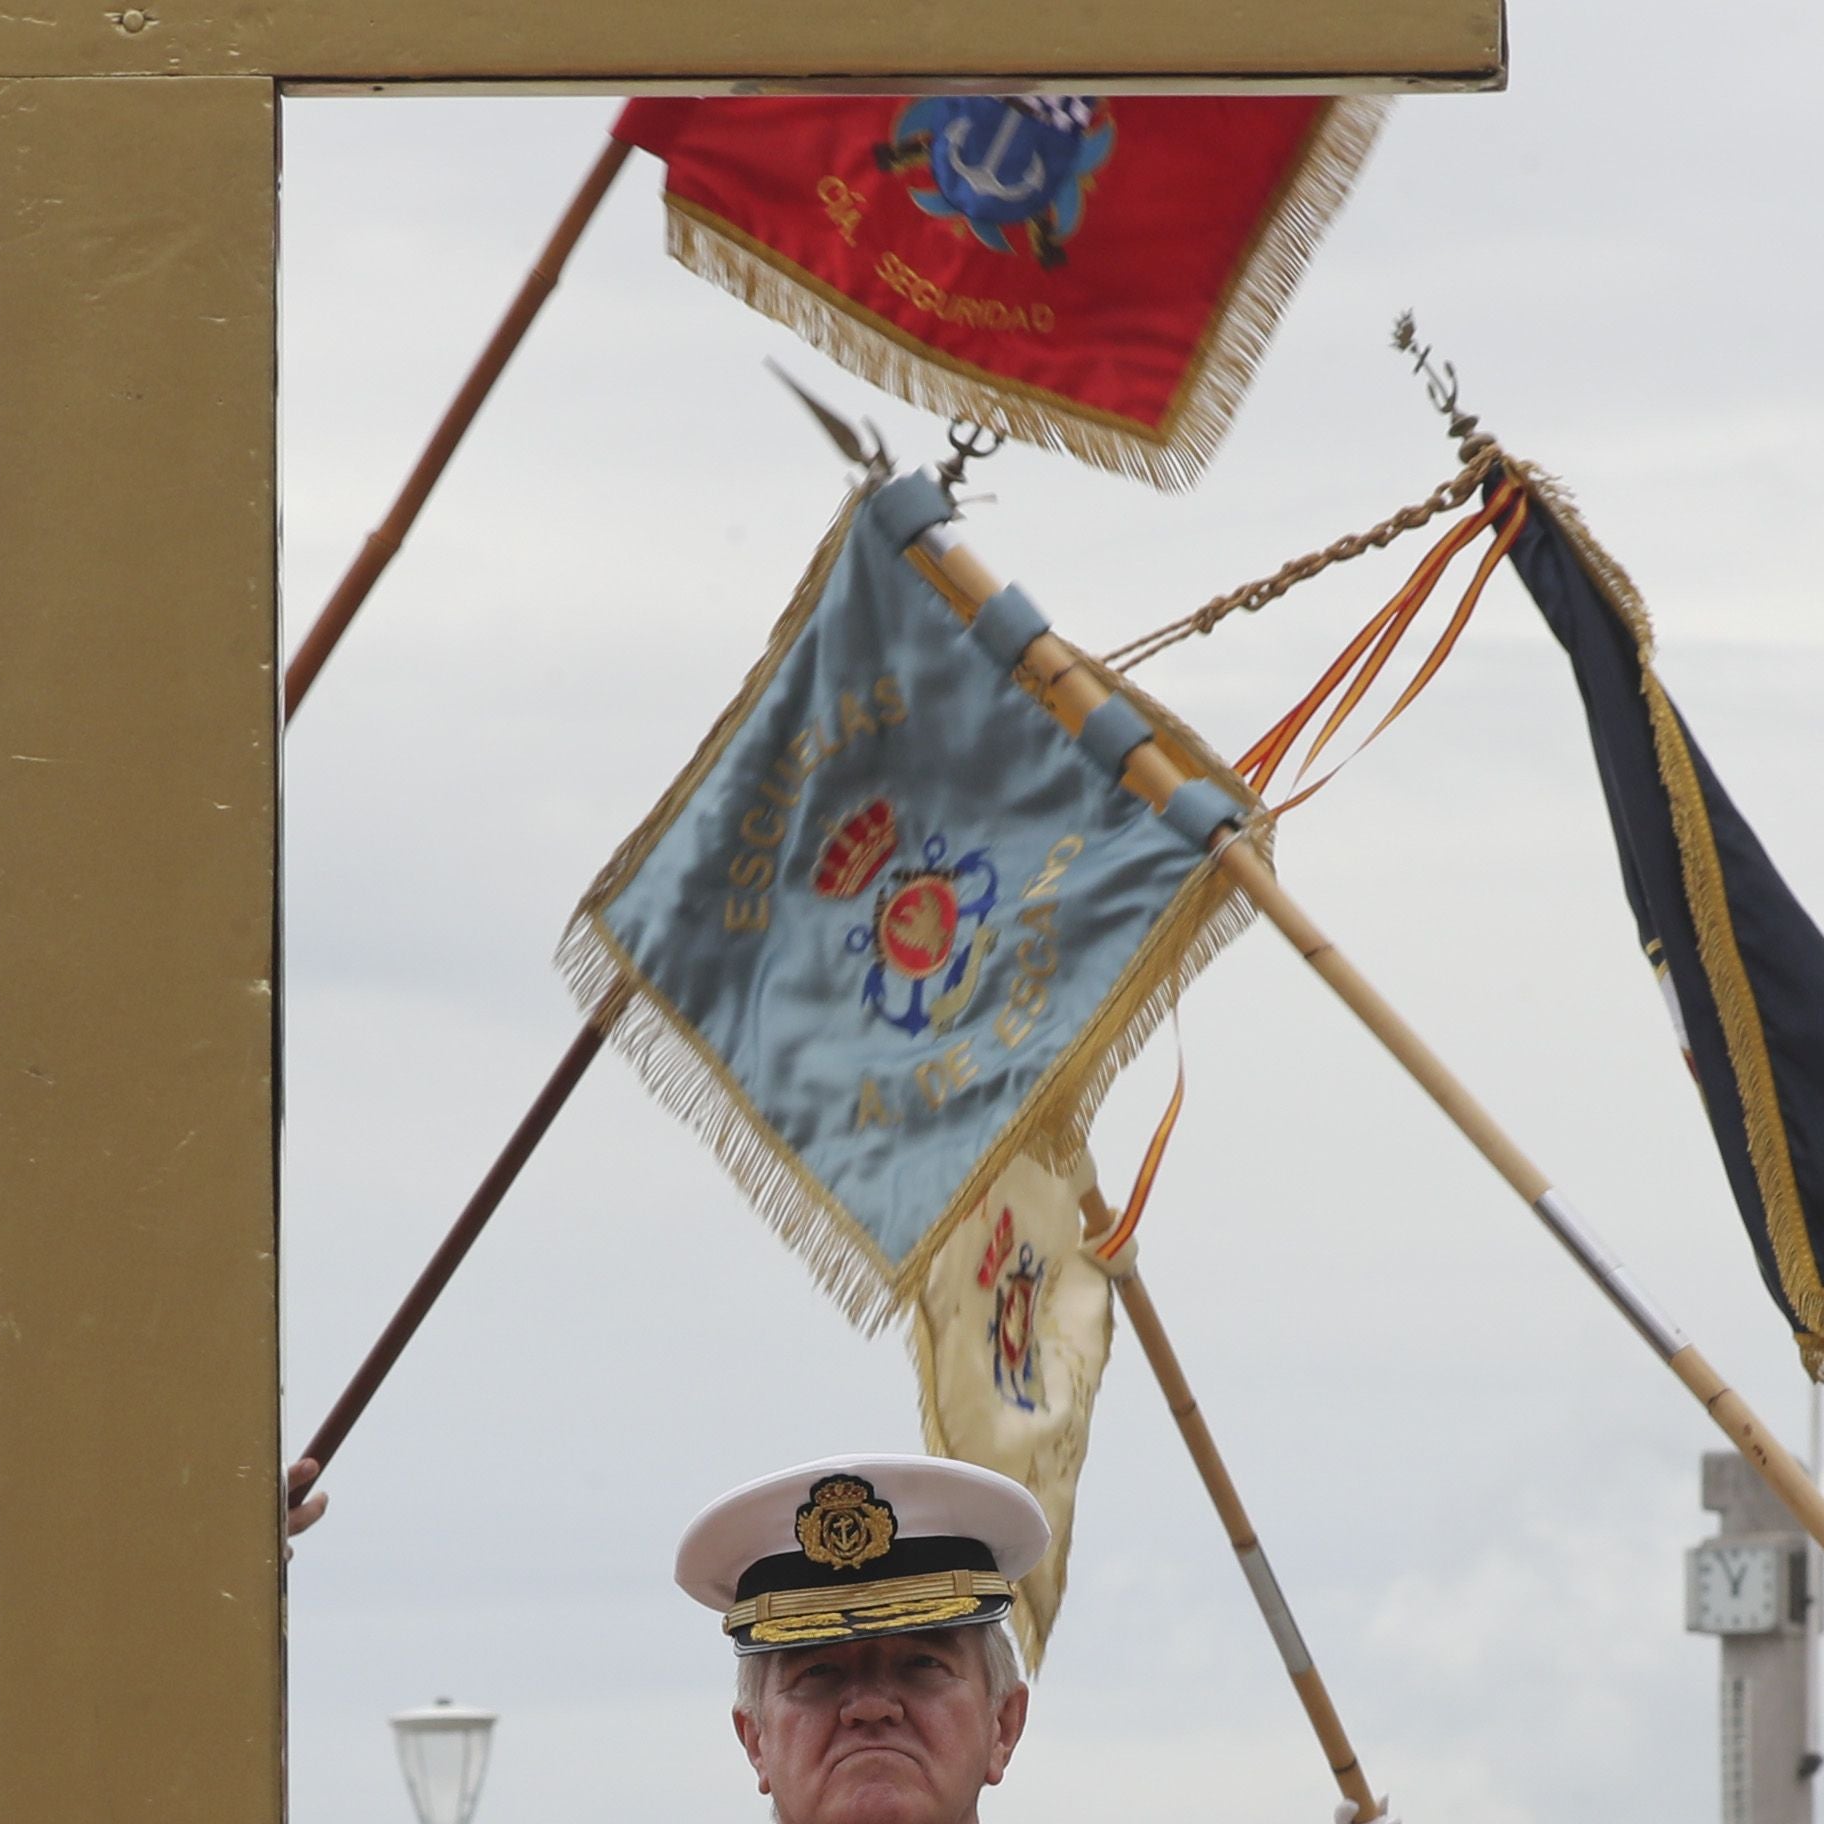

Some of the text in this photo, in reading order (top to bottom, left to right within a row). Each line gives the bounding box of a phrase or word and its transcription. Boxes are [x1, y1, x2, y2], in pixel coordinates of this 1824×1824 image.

[876, 250, 1055, 334] SEGURIDAD
[723, 674, 909, 934] ESCUELAS
[914, 1040, 979, 1112] DE
[993, 834, 1085, 1050] ESCAÑO
